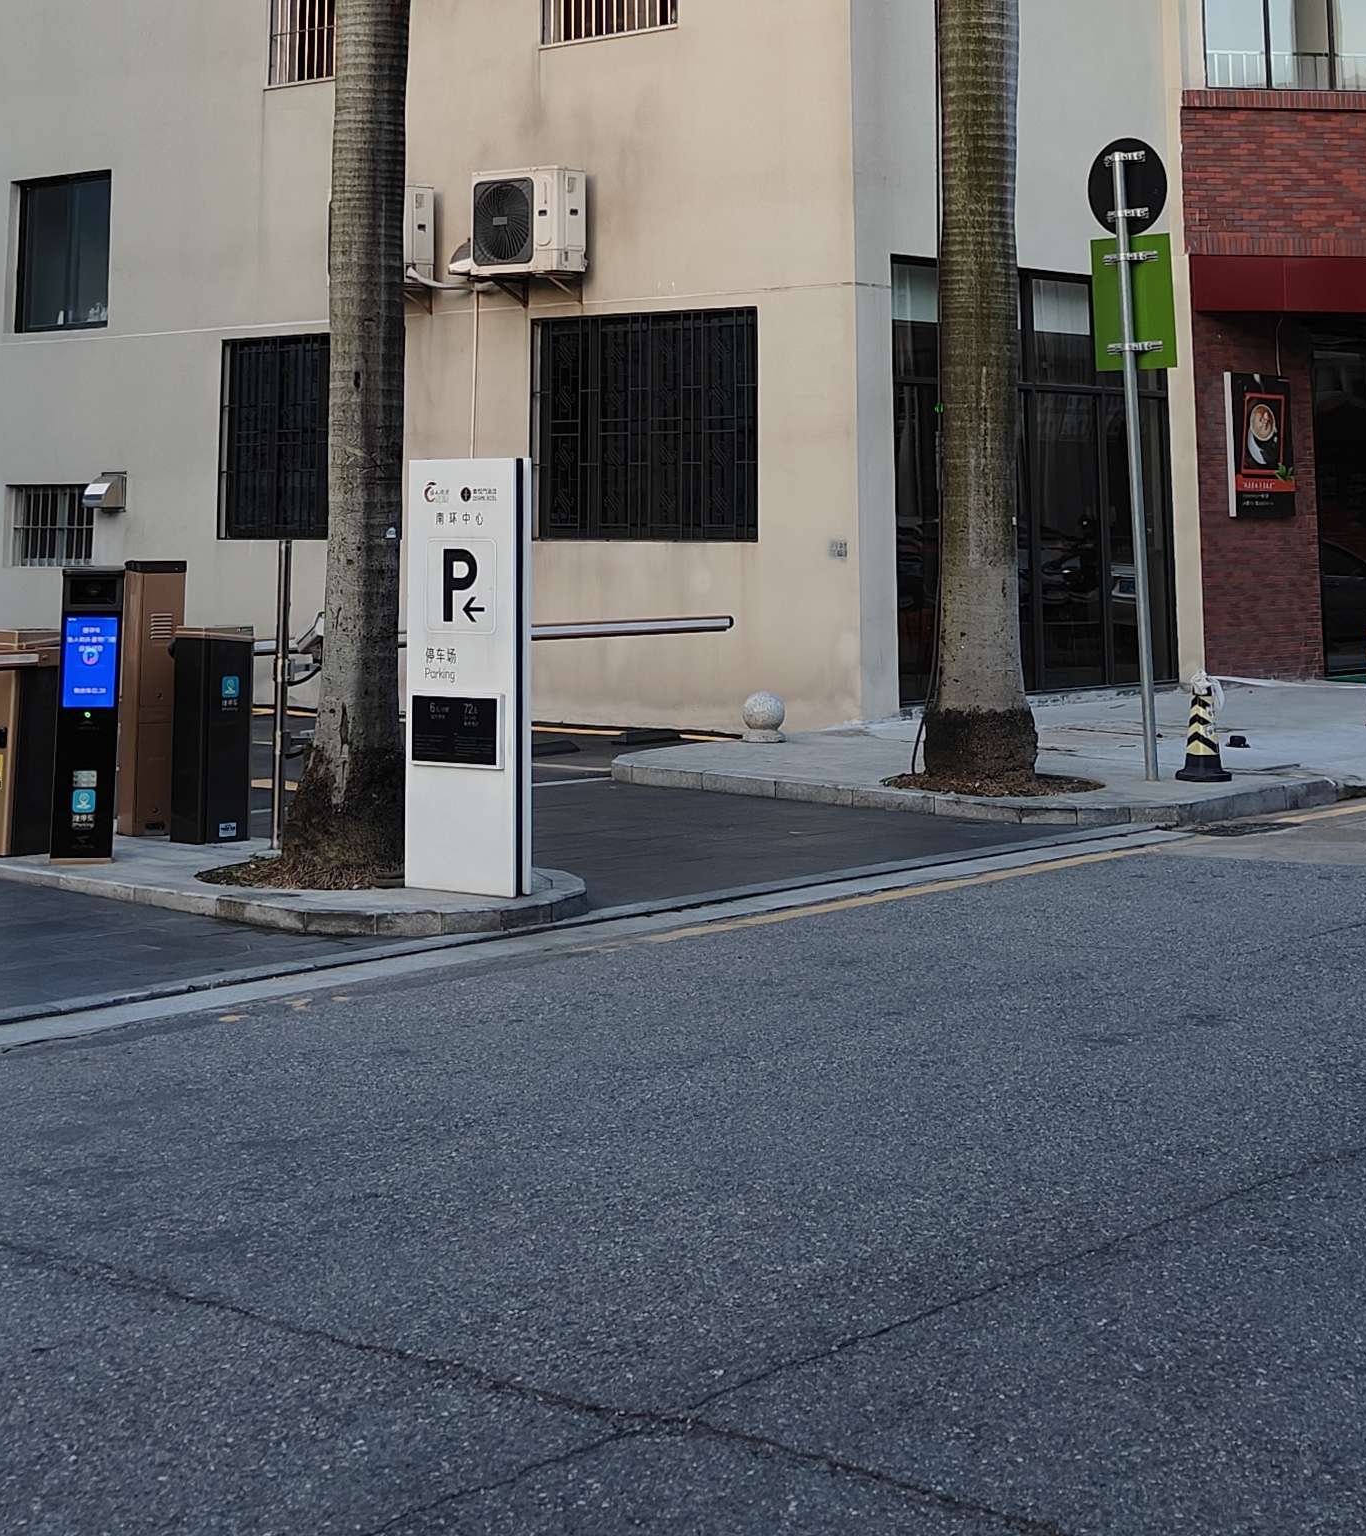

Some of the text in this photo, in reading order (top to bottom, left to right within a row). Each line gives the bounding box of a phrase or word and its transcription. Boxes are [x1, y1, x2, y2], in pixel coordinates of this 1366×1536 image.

[436, 512, 484, 525] 南环中心
[443, 548, 478, 622] P
[425, 647, 457, 664] 停车场
[425, 668, 456, 683] Parking
